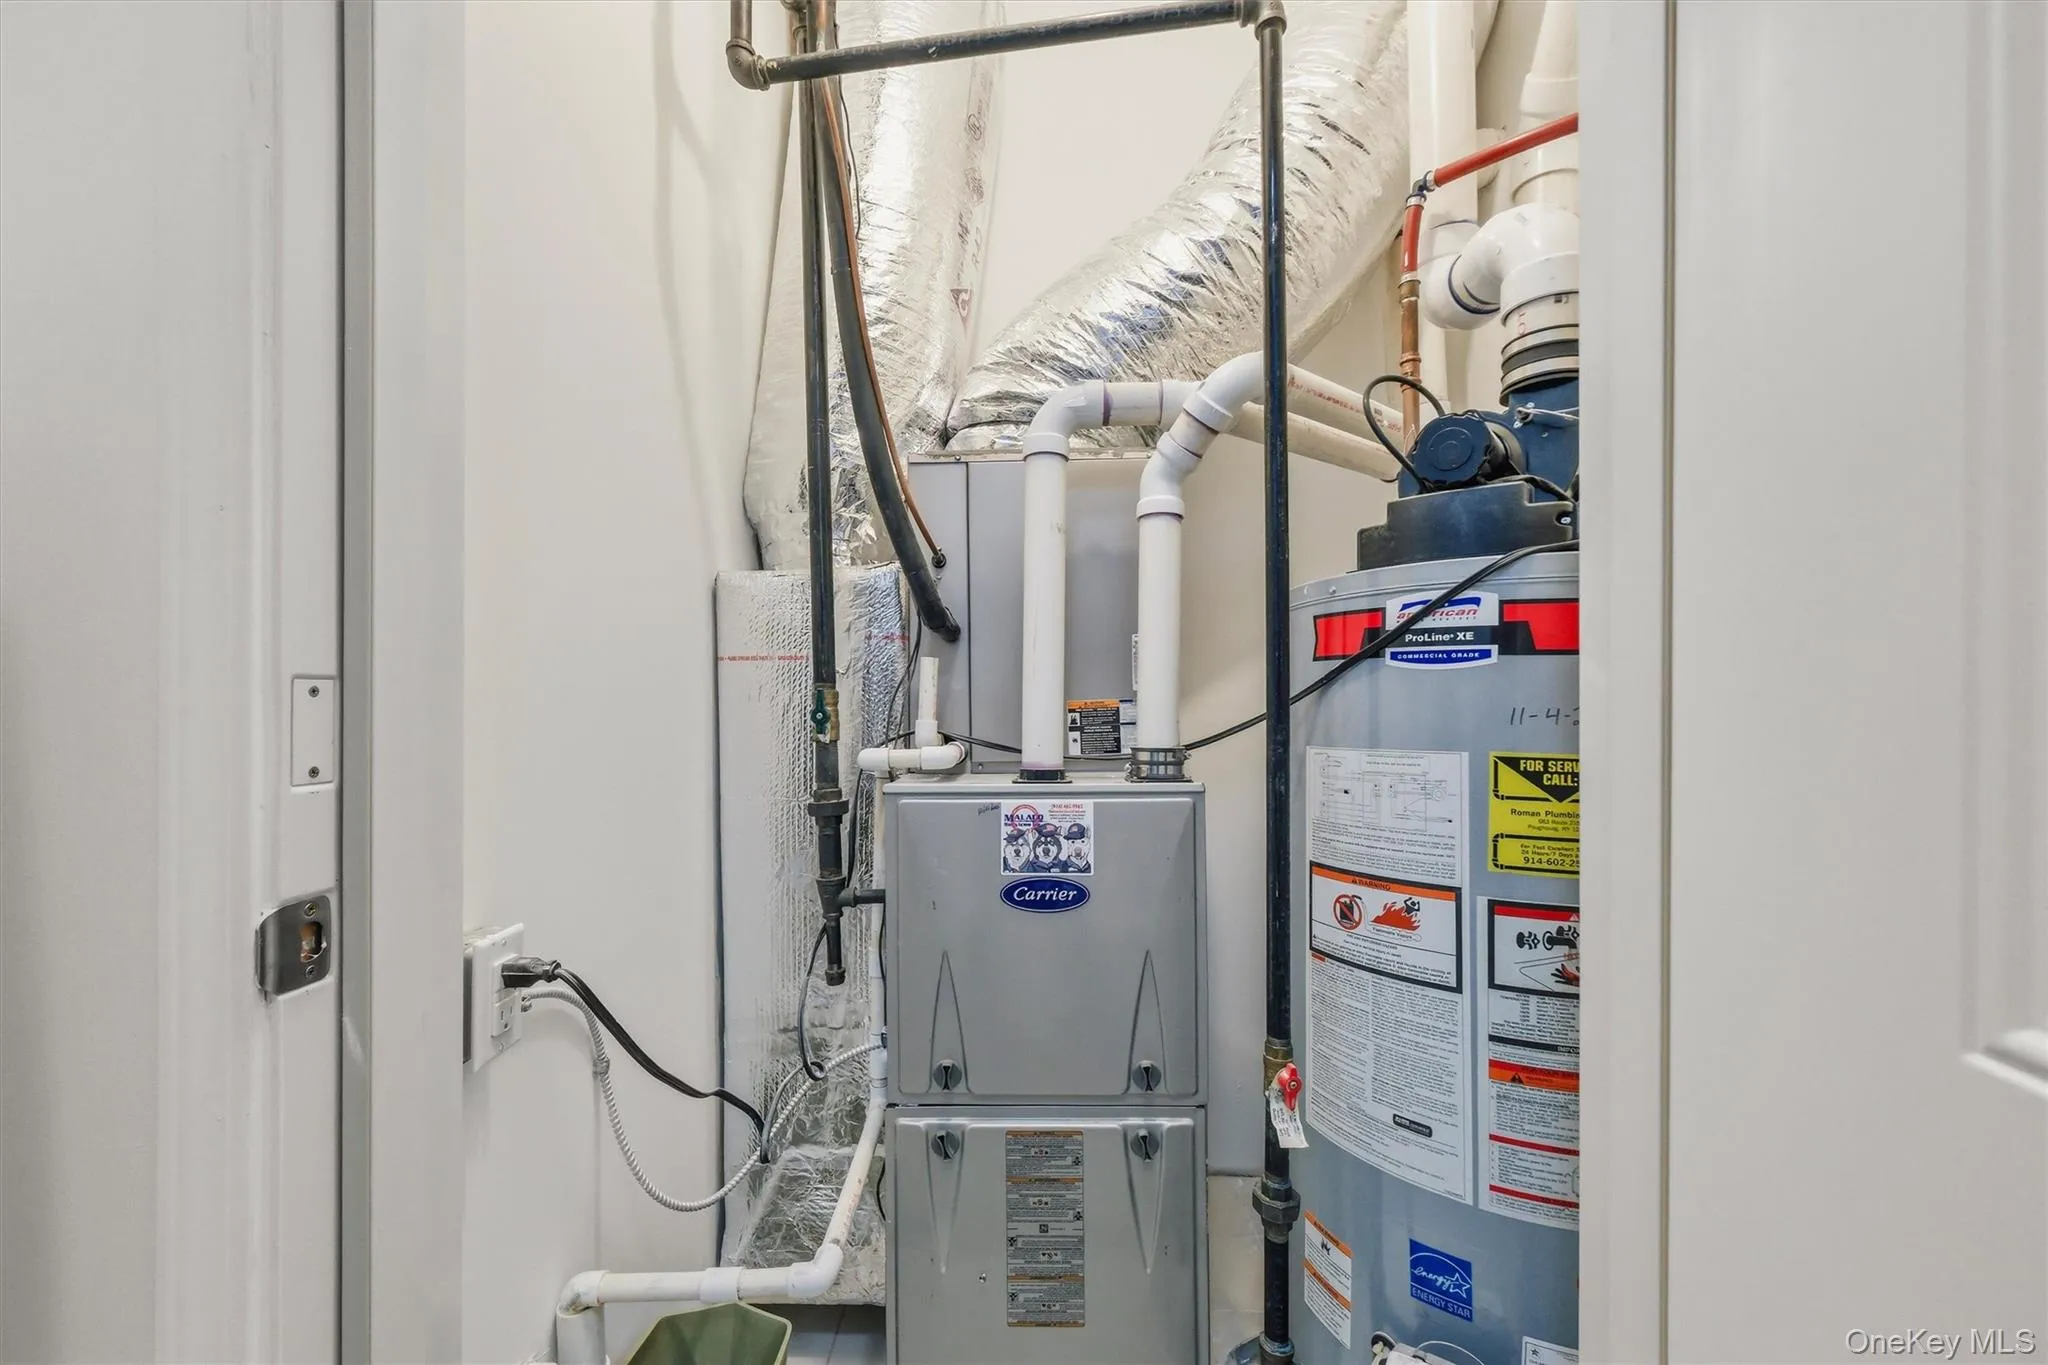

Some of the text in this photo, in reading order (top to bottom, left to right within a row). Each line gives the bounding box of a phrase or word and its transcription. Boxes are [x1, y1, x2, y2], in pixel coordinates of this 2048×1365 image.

[1396, 608, 1478, 620] arican
[1456, 632, 1475, 640] XE
[1520, 759, 1545, 772] FOR
[1542, 773, 1578, 786] CALL:
[1510, 808, 1541, 817] Roman
[1357, 878, 1391, 891] WARNING
[1013, 886, 1077, 901] Carrier
[1411, 1266, 1453, 1291] energy
[1412, 1287, 1471, 1318] ENERGY STAR
